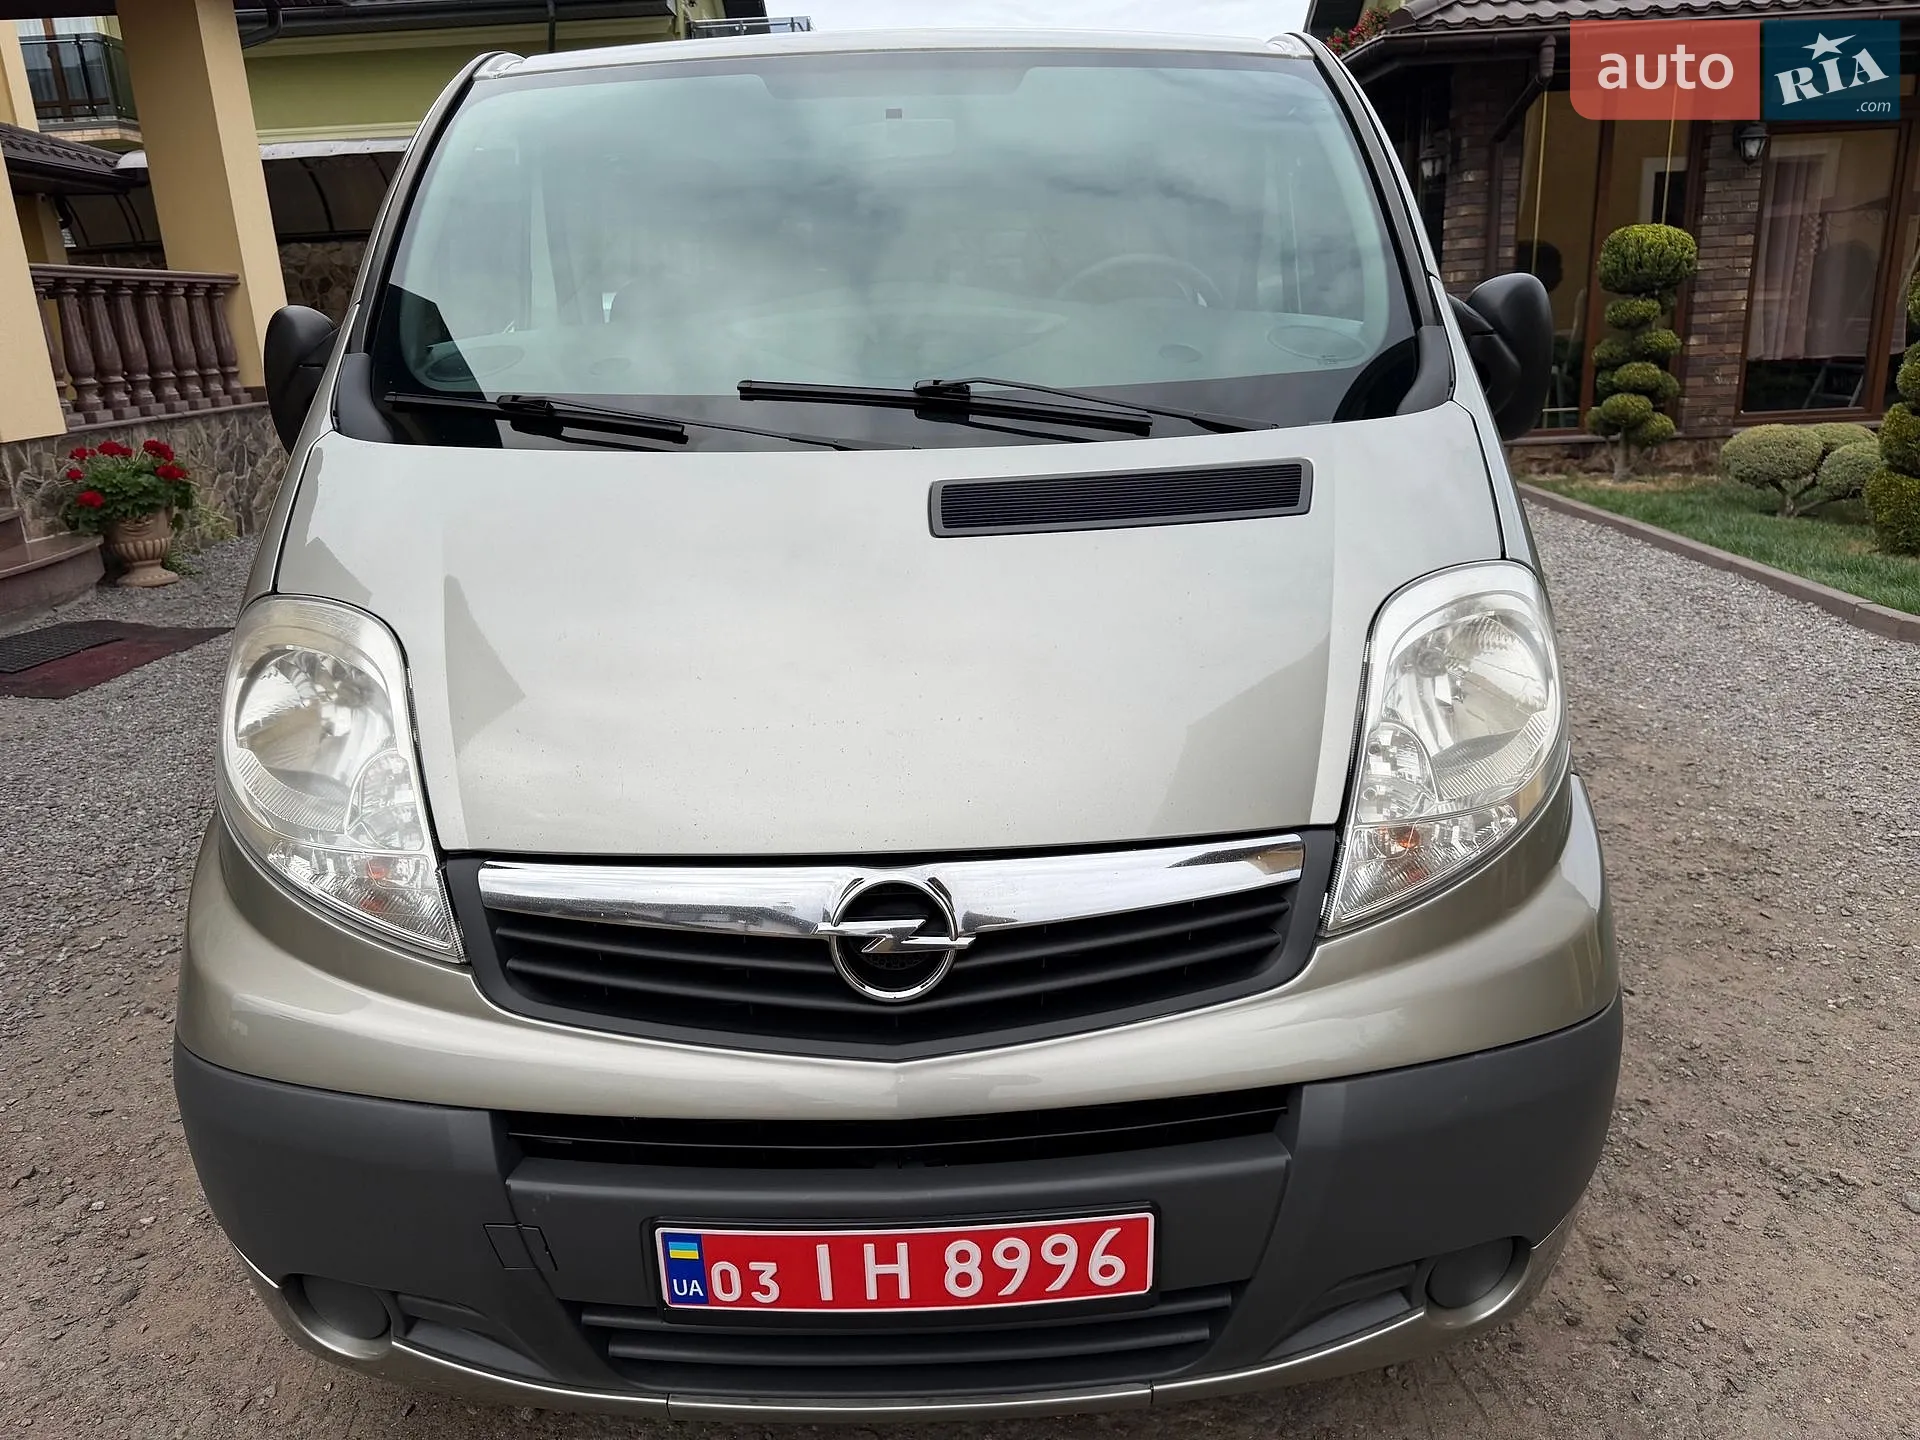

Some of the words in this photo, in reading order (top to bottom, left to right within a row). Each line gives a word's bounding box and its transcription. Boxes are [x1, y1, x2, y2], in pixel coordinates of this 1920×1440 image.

[673, 1278, 704, 1297] UA
[710, 1261, 780, 1303] 03
[944, 1227, 1126, 1299] 8996
